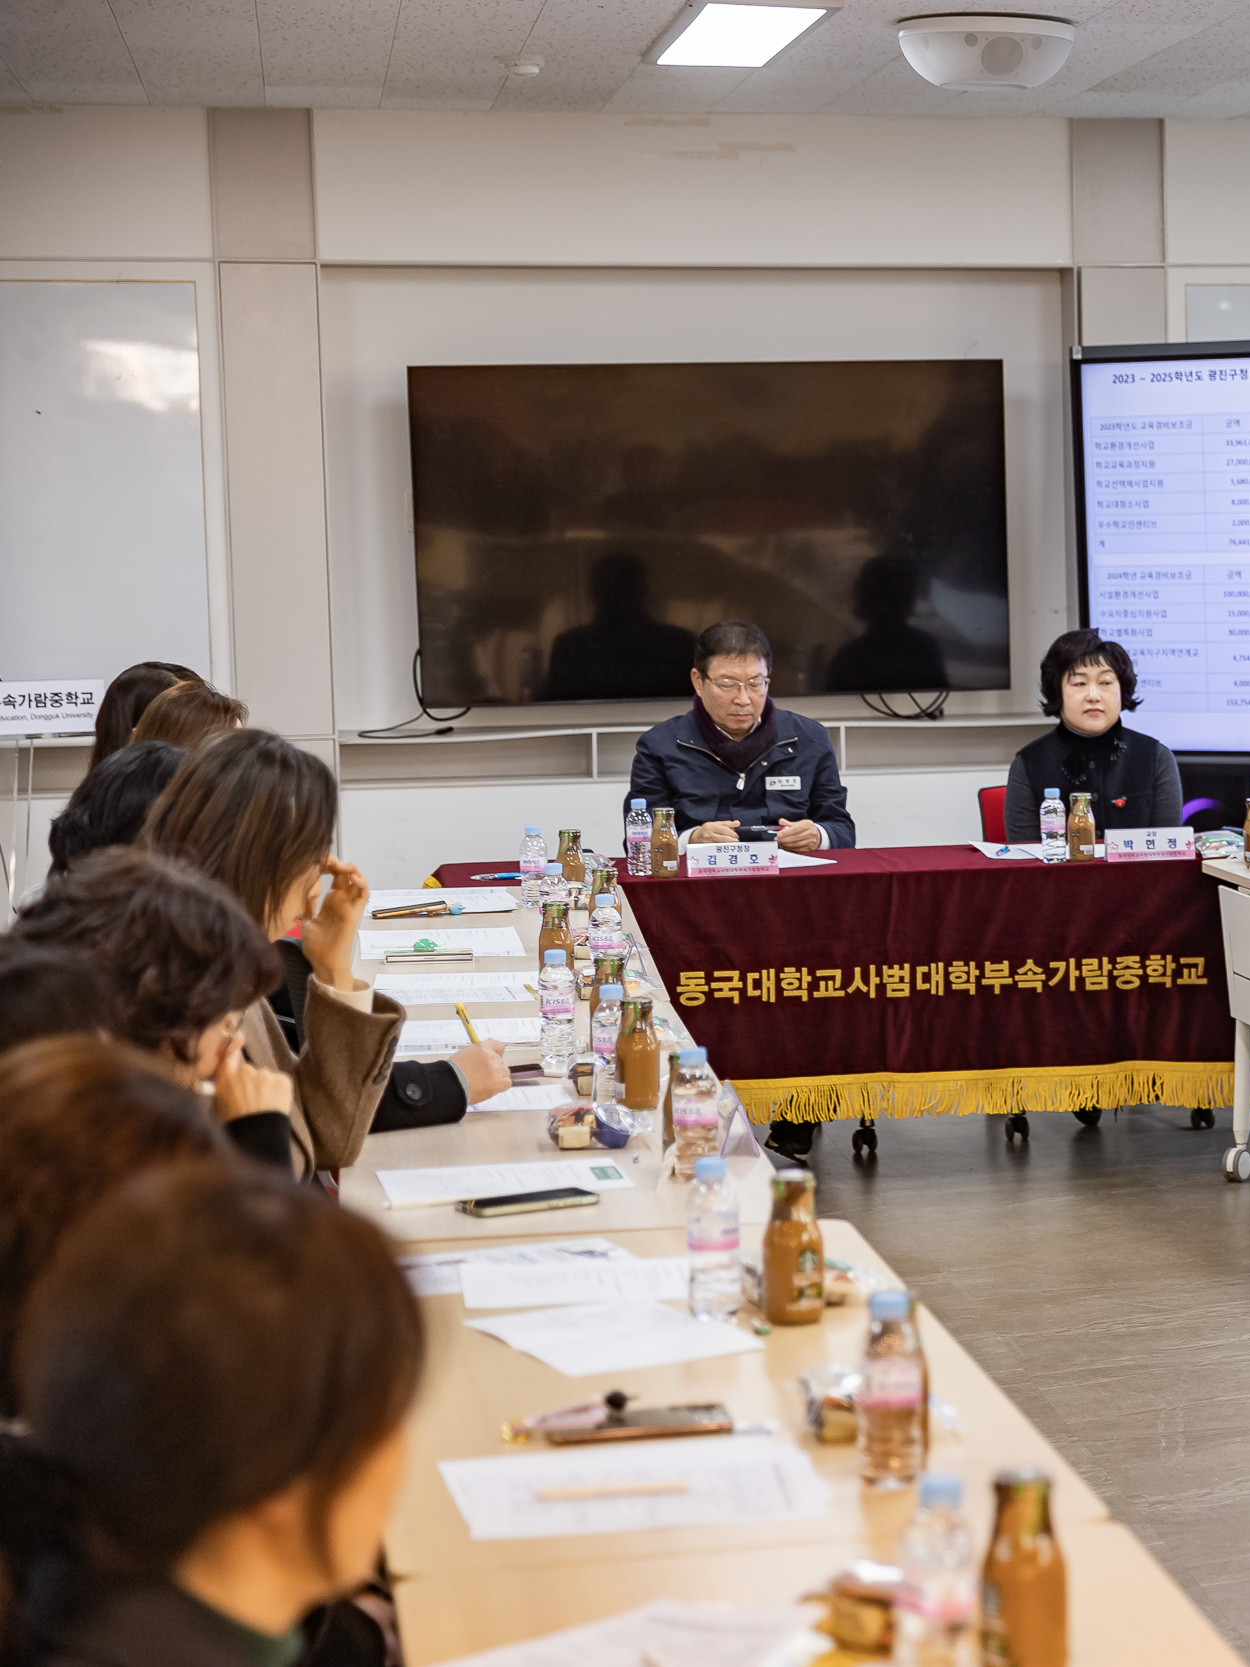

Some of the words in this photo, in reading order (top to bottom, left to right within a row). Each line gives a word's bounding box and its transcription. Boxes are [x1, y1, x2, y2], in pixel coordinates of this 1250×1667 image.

[1112, 373, 1136, 384] 2023
[1150, 370, 1204, 383] 2025학년도
[1208, 368, 1249, 381] 광진구청
[1225, 418, 1241, 428] 금액
[0, 691, 95, 709] 속가람중학교
[715, 845, 751, 854] 광진구청장
[707, 853, 760, 866] 김경호
[675, 953, 1209, 1007] 동국대학교사범대학부속가람중학교
